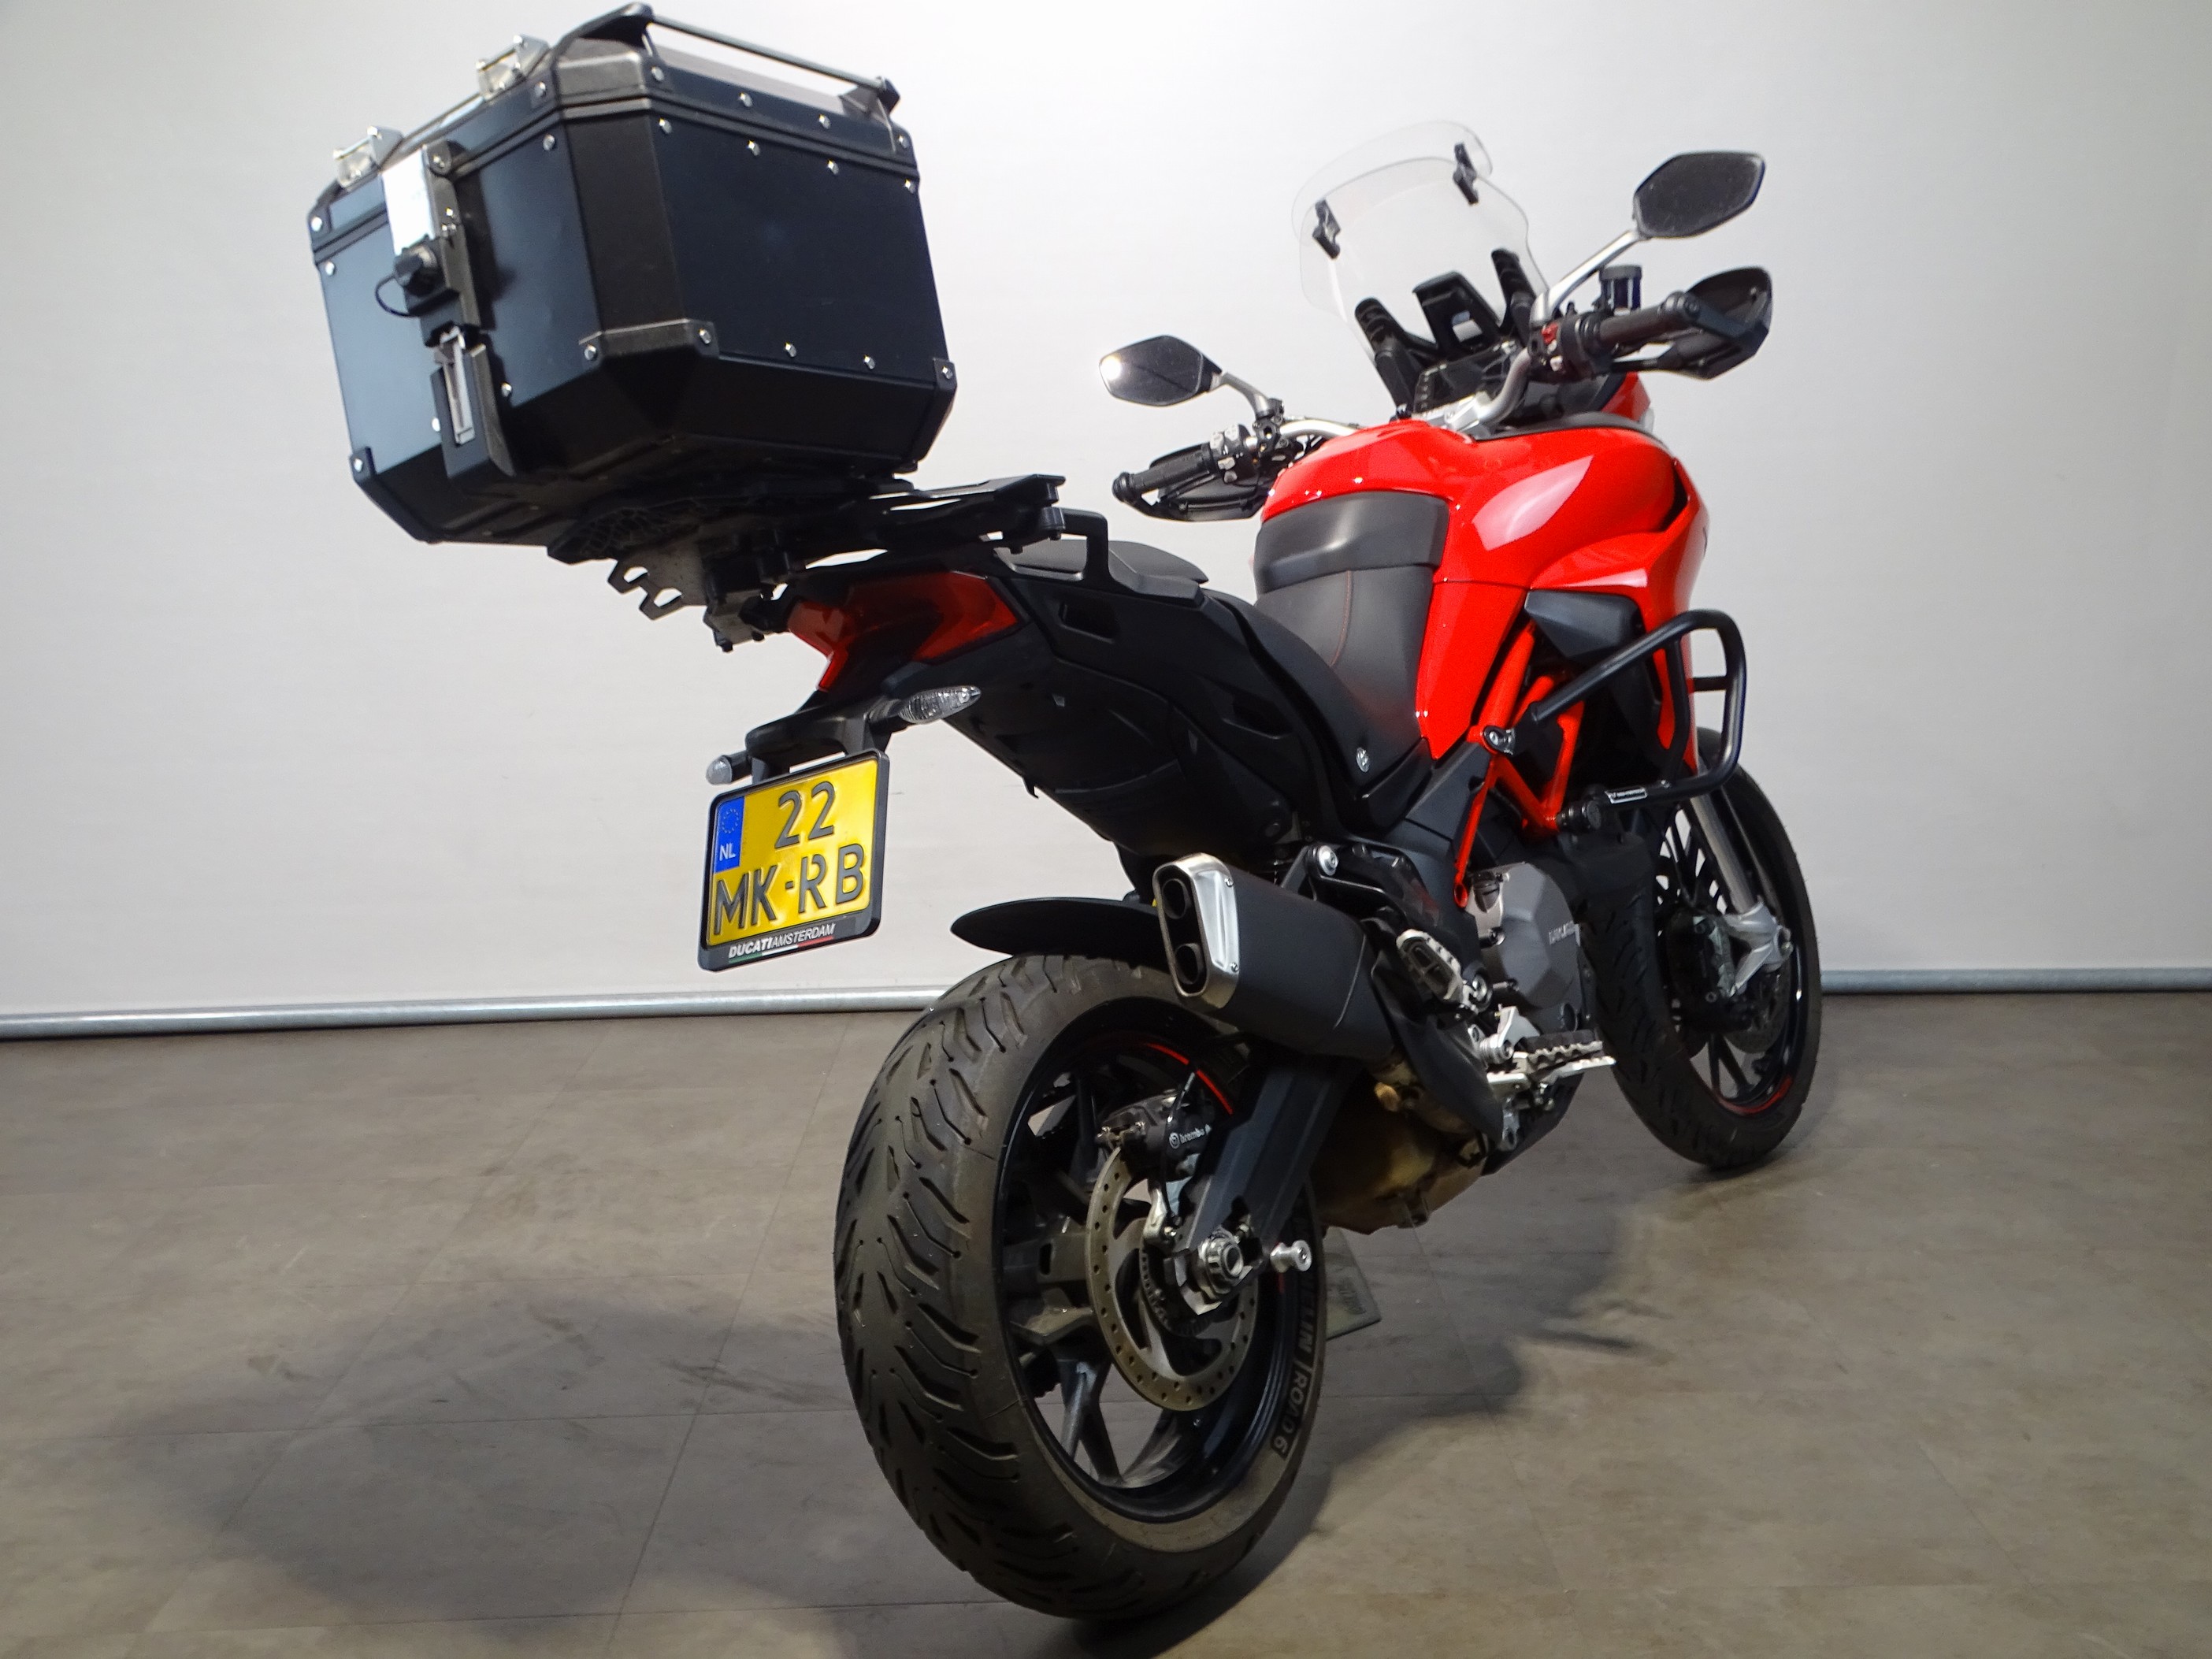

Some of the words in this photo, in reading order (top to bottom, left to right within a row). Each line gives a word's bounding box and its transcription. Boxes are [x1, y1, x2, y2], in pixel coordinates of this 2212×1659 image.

[775, 781, 835, 849] 22
[719, 843, 737, 861] NL
[714, 844, 863, 935] MK-RB
[1282, 1371, 1310, 1434] ROAD
[1273, 1435, 1288, 1453] 6
